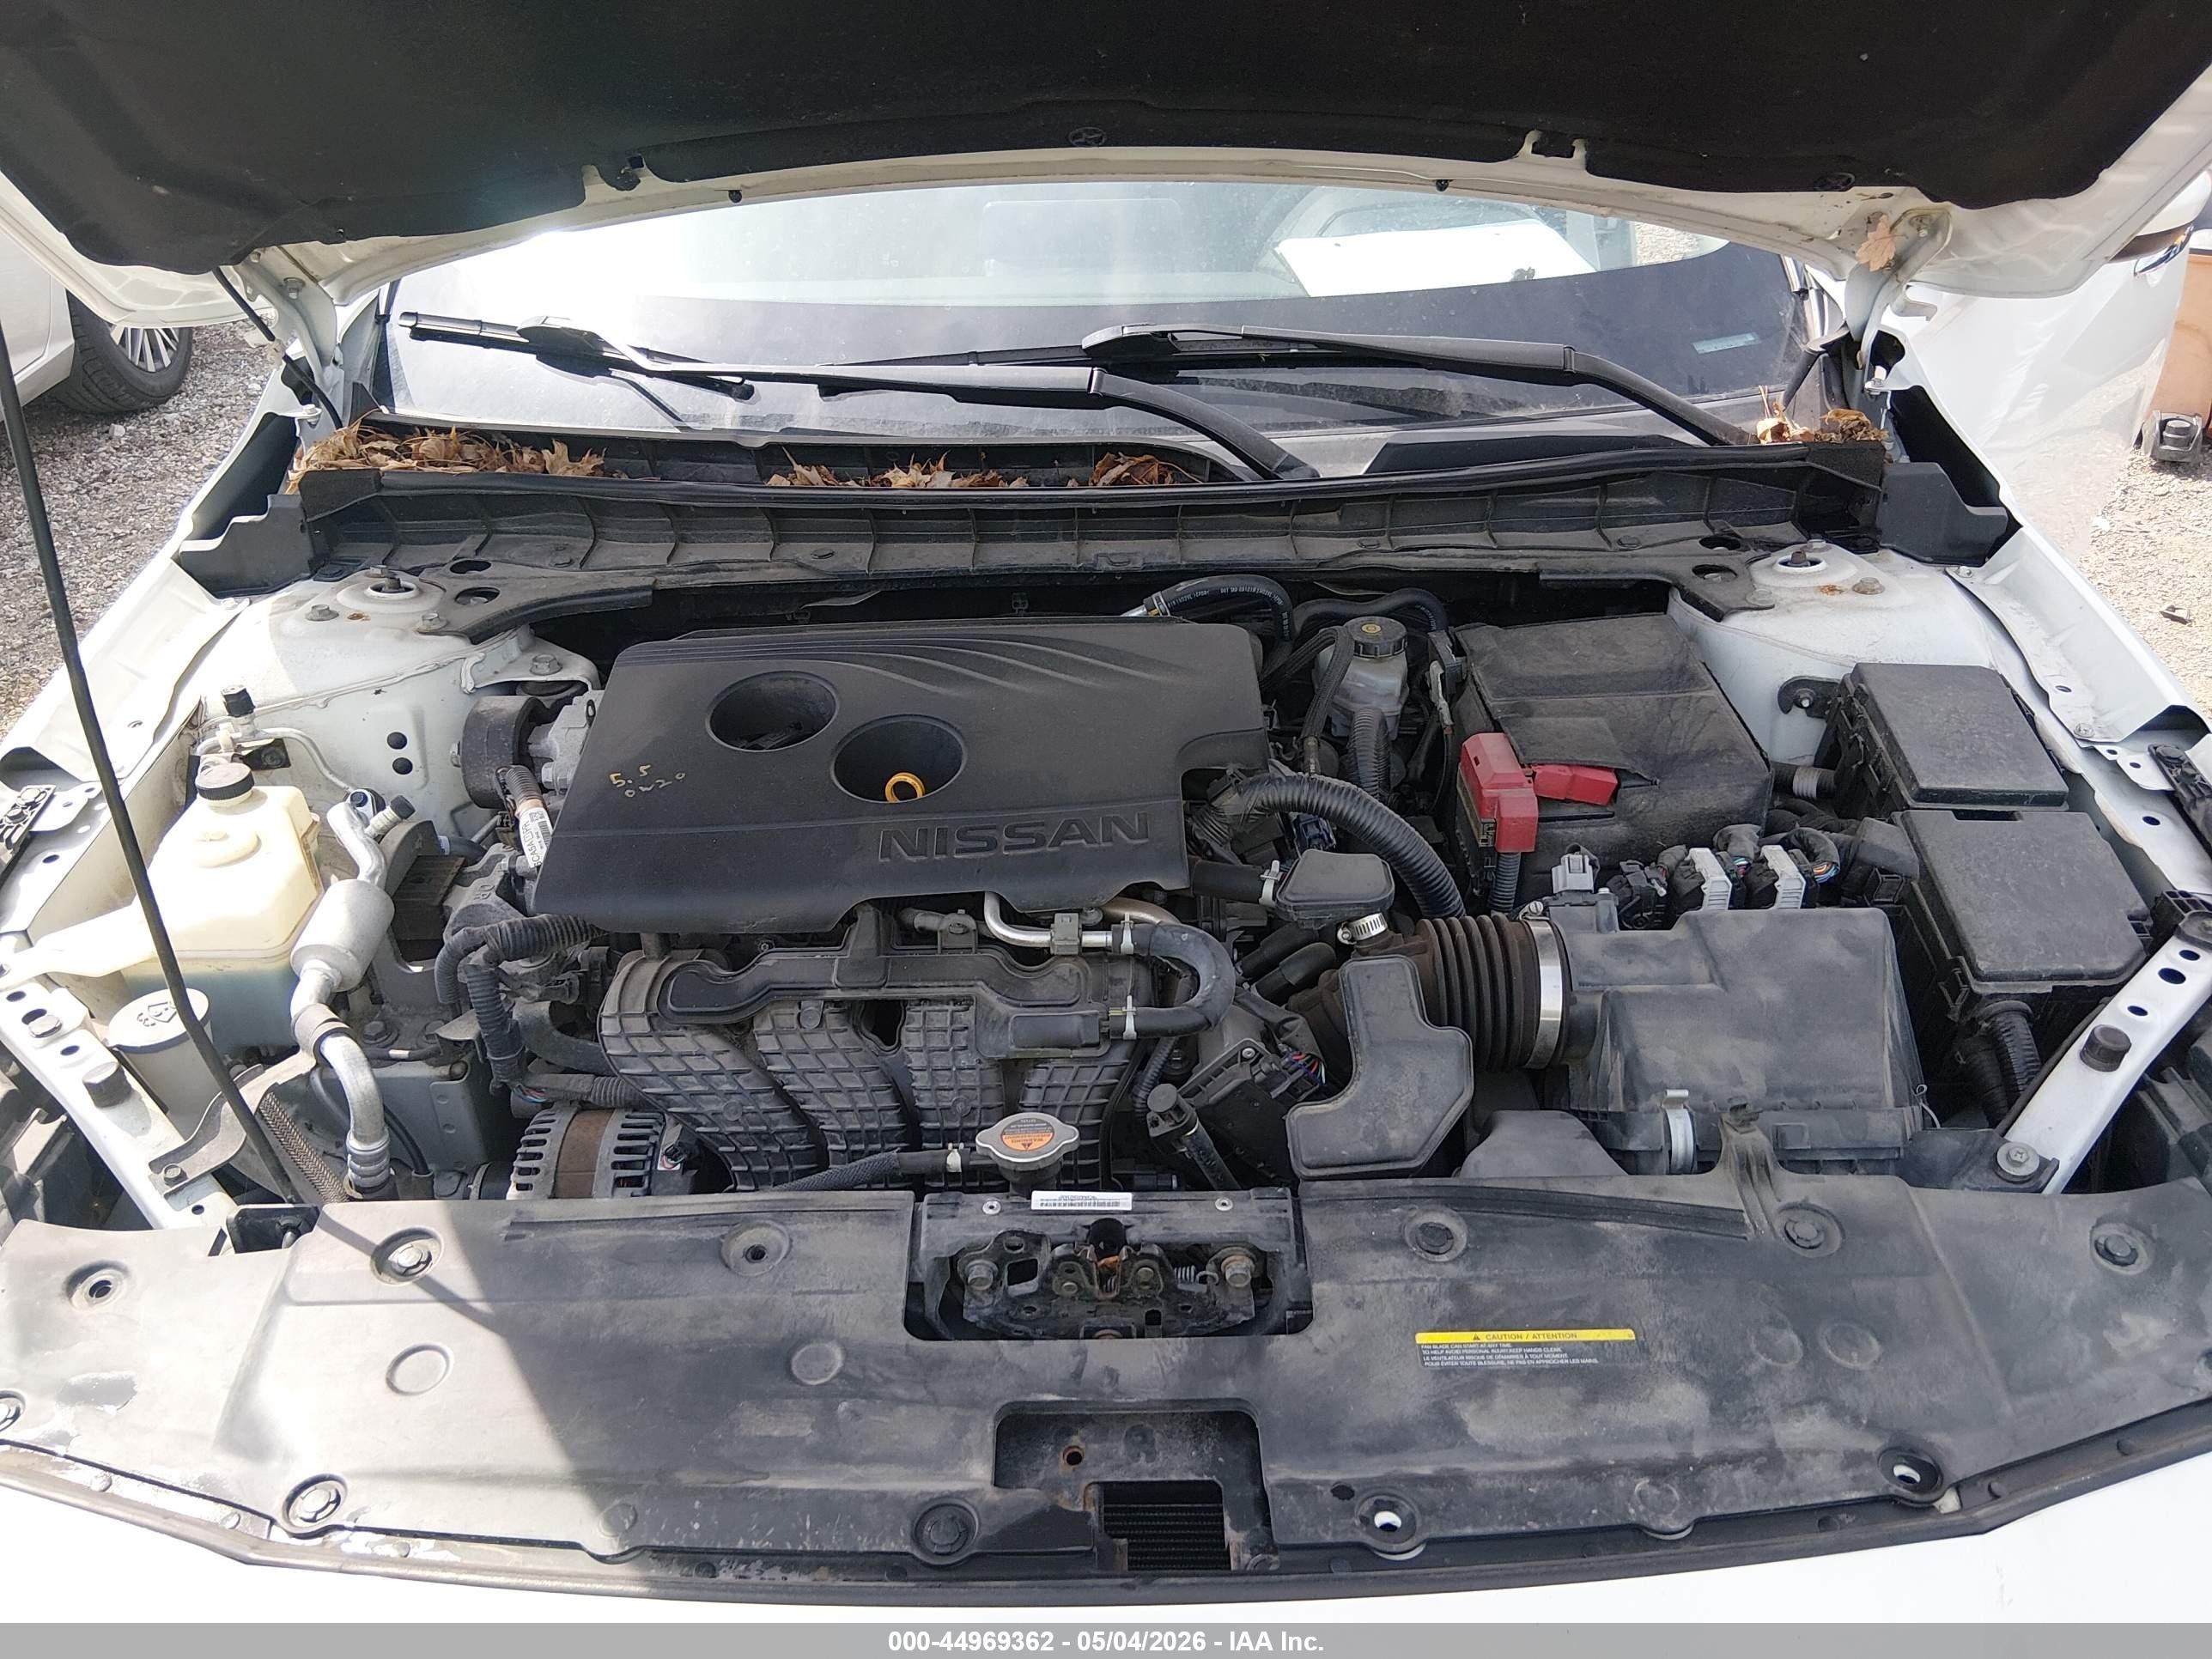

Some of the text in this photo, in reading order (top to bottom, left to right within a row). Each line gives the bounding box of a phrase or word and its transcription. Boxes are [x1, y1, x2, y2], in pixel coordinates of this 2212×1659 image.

[878, 811, 1150, 862] NISSAN
[1485, 1332, 1523, 1340] CAUTION
[1532, 1331, 1577, 1340] ATTENTION
